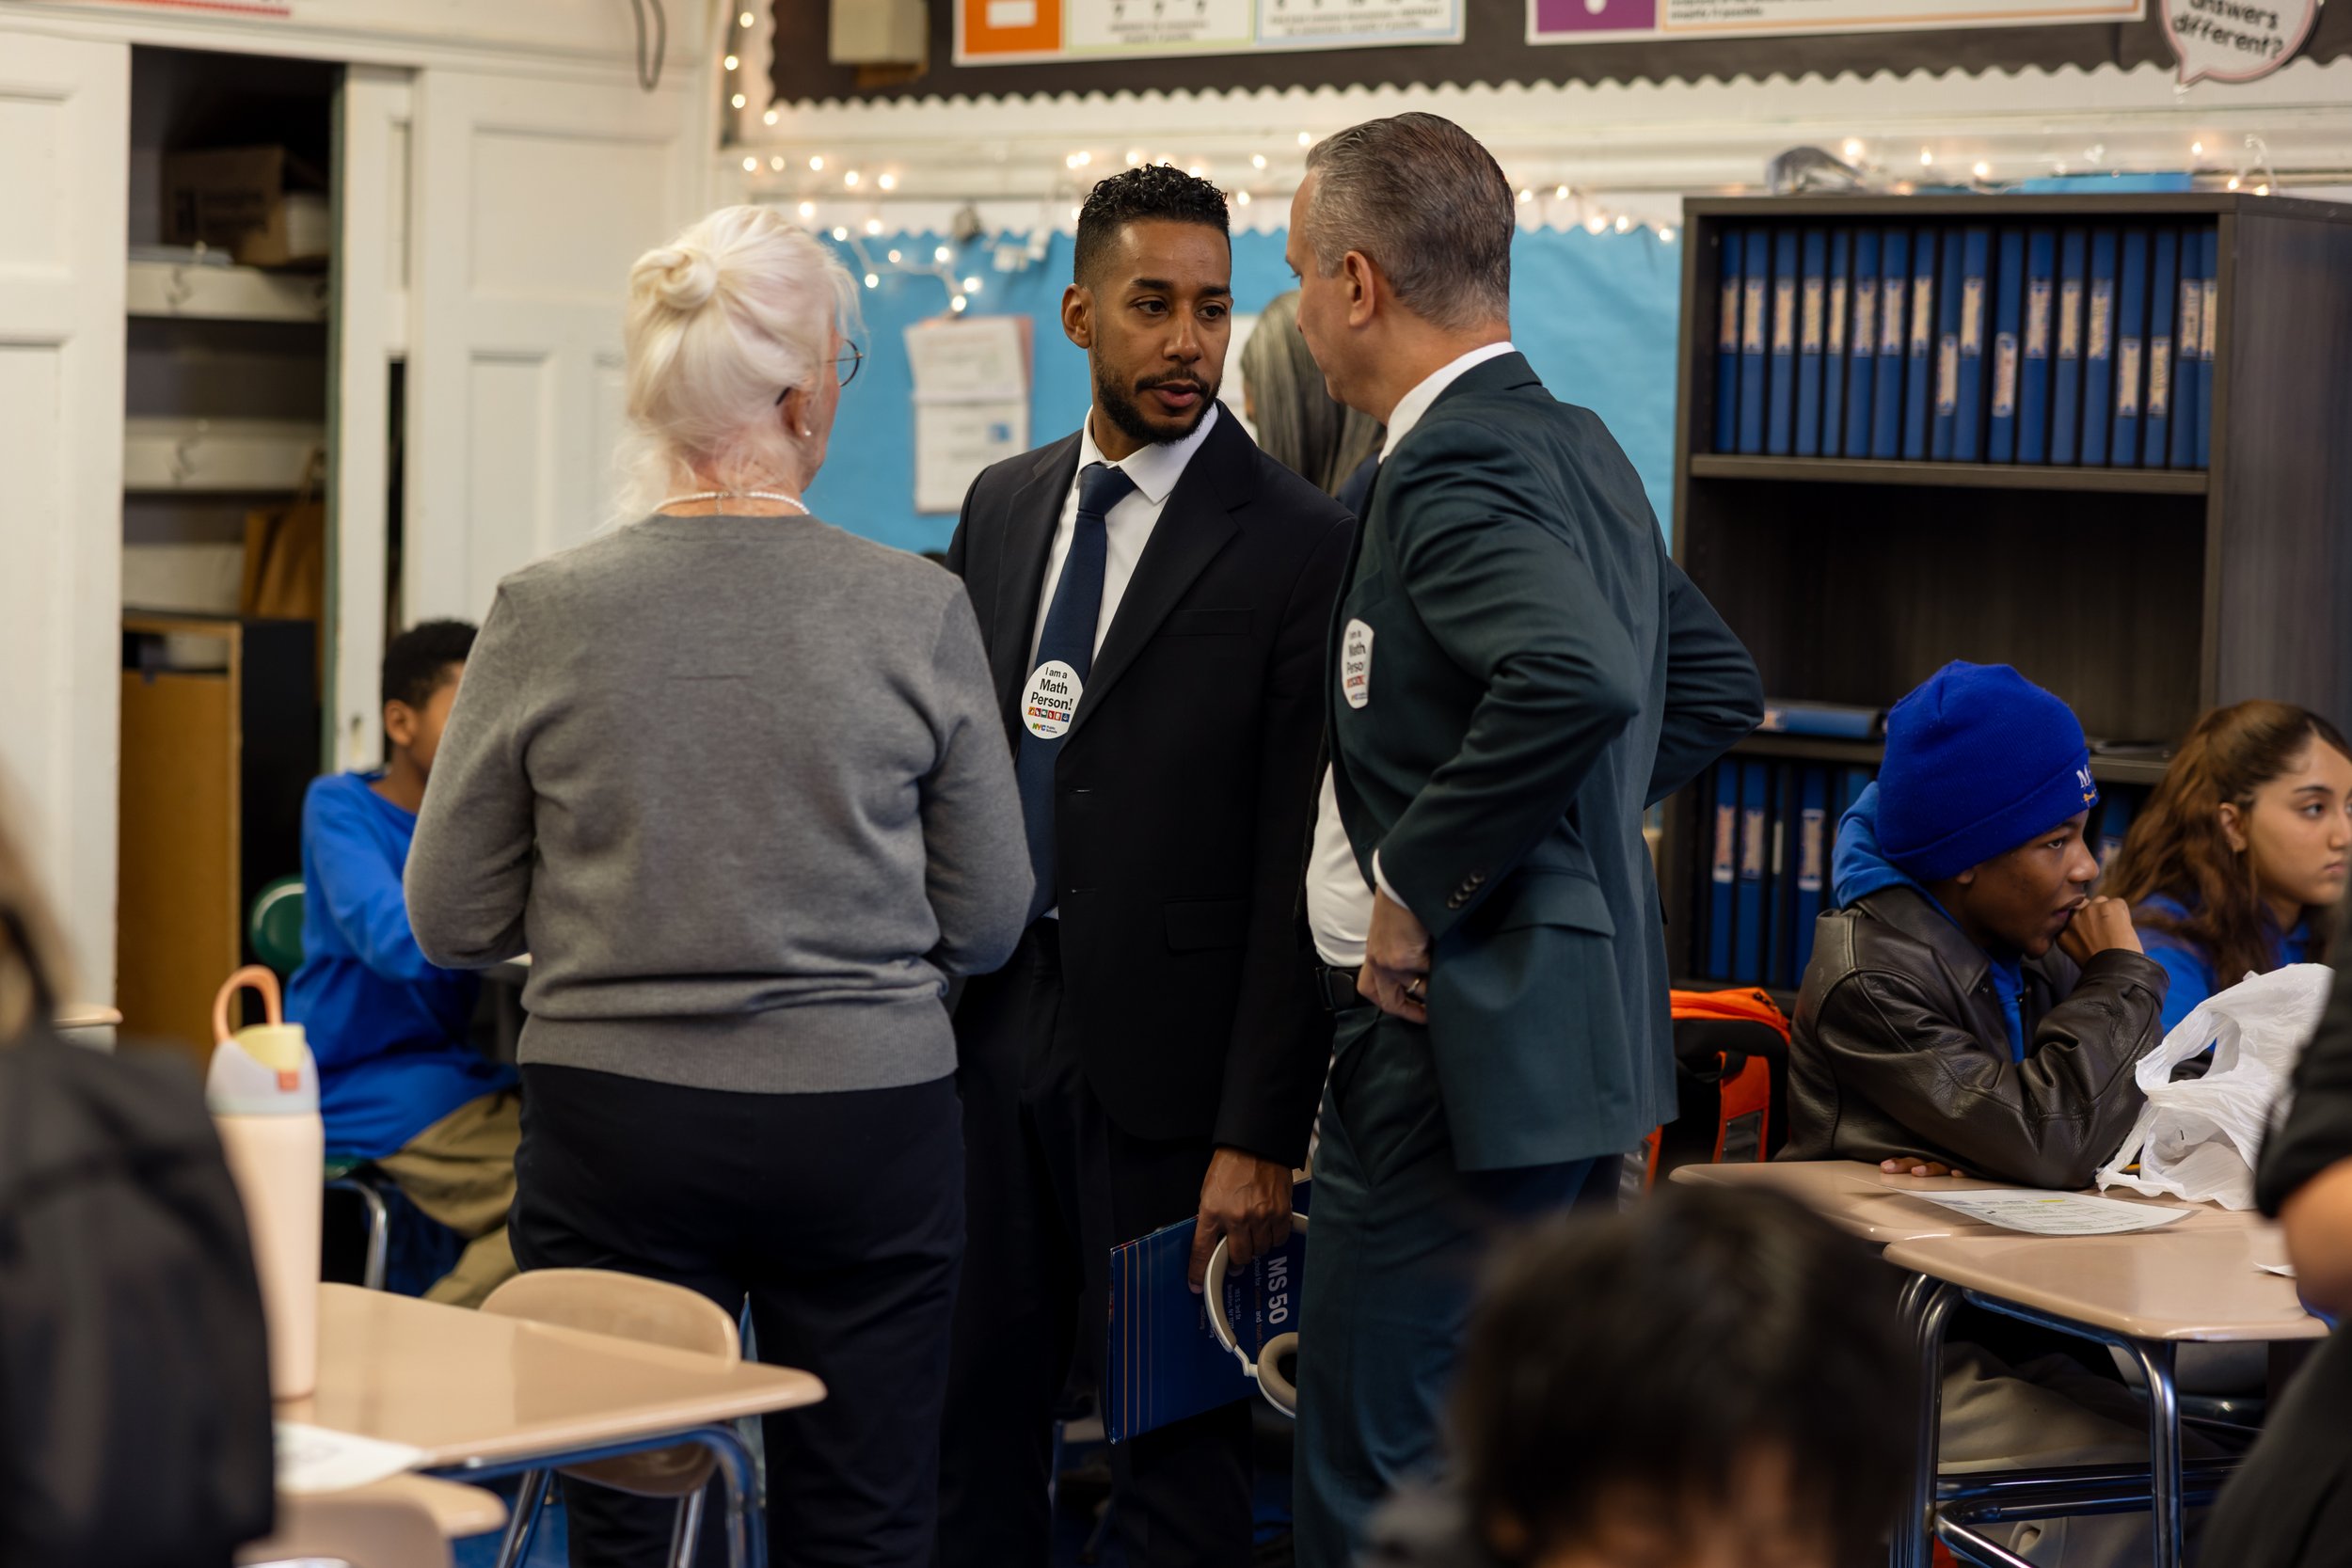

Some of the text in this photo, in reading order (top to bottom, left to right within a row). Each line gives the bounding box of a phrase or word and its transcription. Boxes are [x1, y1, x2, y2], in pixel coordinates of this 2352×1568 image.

[2171, 12, 2284, 58] different?
[1045, 667, 1049, 675] I
[1049, 669, 1061, 678] am
[1040, 678, 1068, 695] Math
[1030, 691, 1073, 710] Person!
[1032, 722, 1046, 731] NYC
[1268, 1256, 1289, 1324] MS 50
